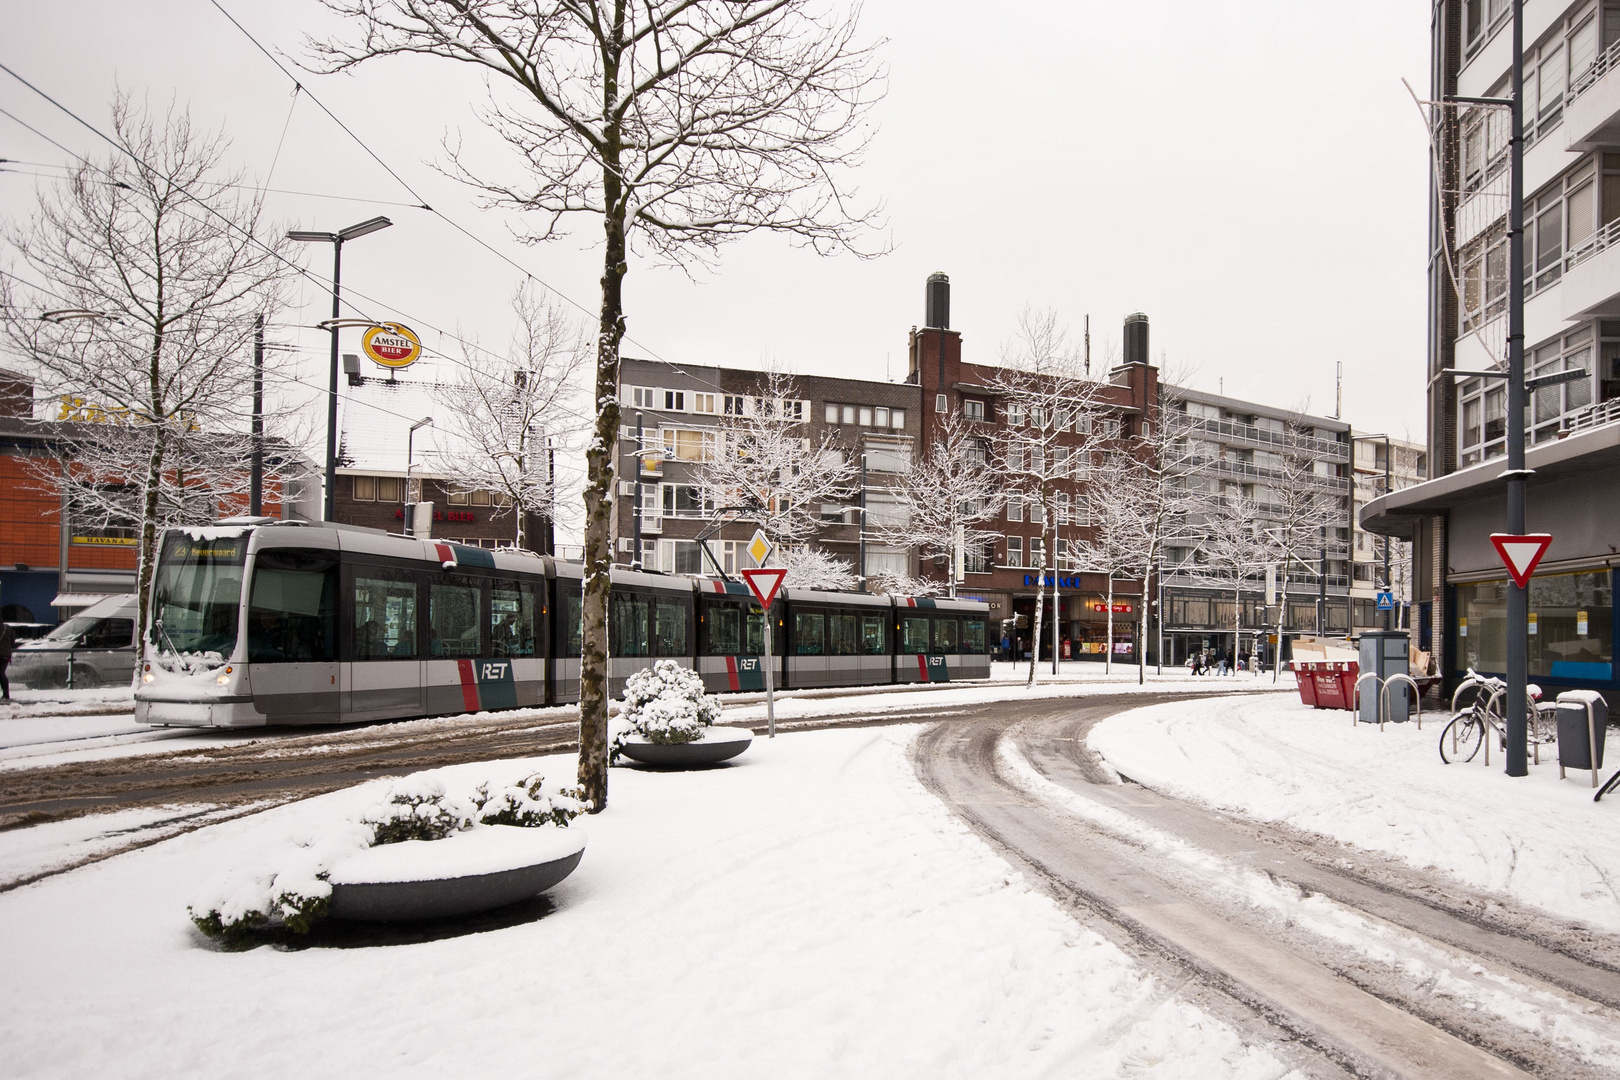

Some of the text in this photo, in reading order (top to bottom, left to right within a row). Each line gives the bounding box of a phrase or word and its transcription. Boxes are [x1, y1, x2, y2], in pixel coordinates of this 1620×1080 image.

[374, 336, 411, 348] AMSTEL
[382, 346, 402, 355] BIER
[394, 509, 475, 521] AEL BIER
[174, 547, 186, 557] 23
[740, 658, 758, 670] RET
[929, 656, 944, 666] RET
[481, 663, 508, 680] RET
